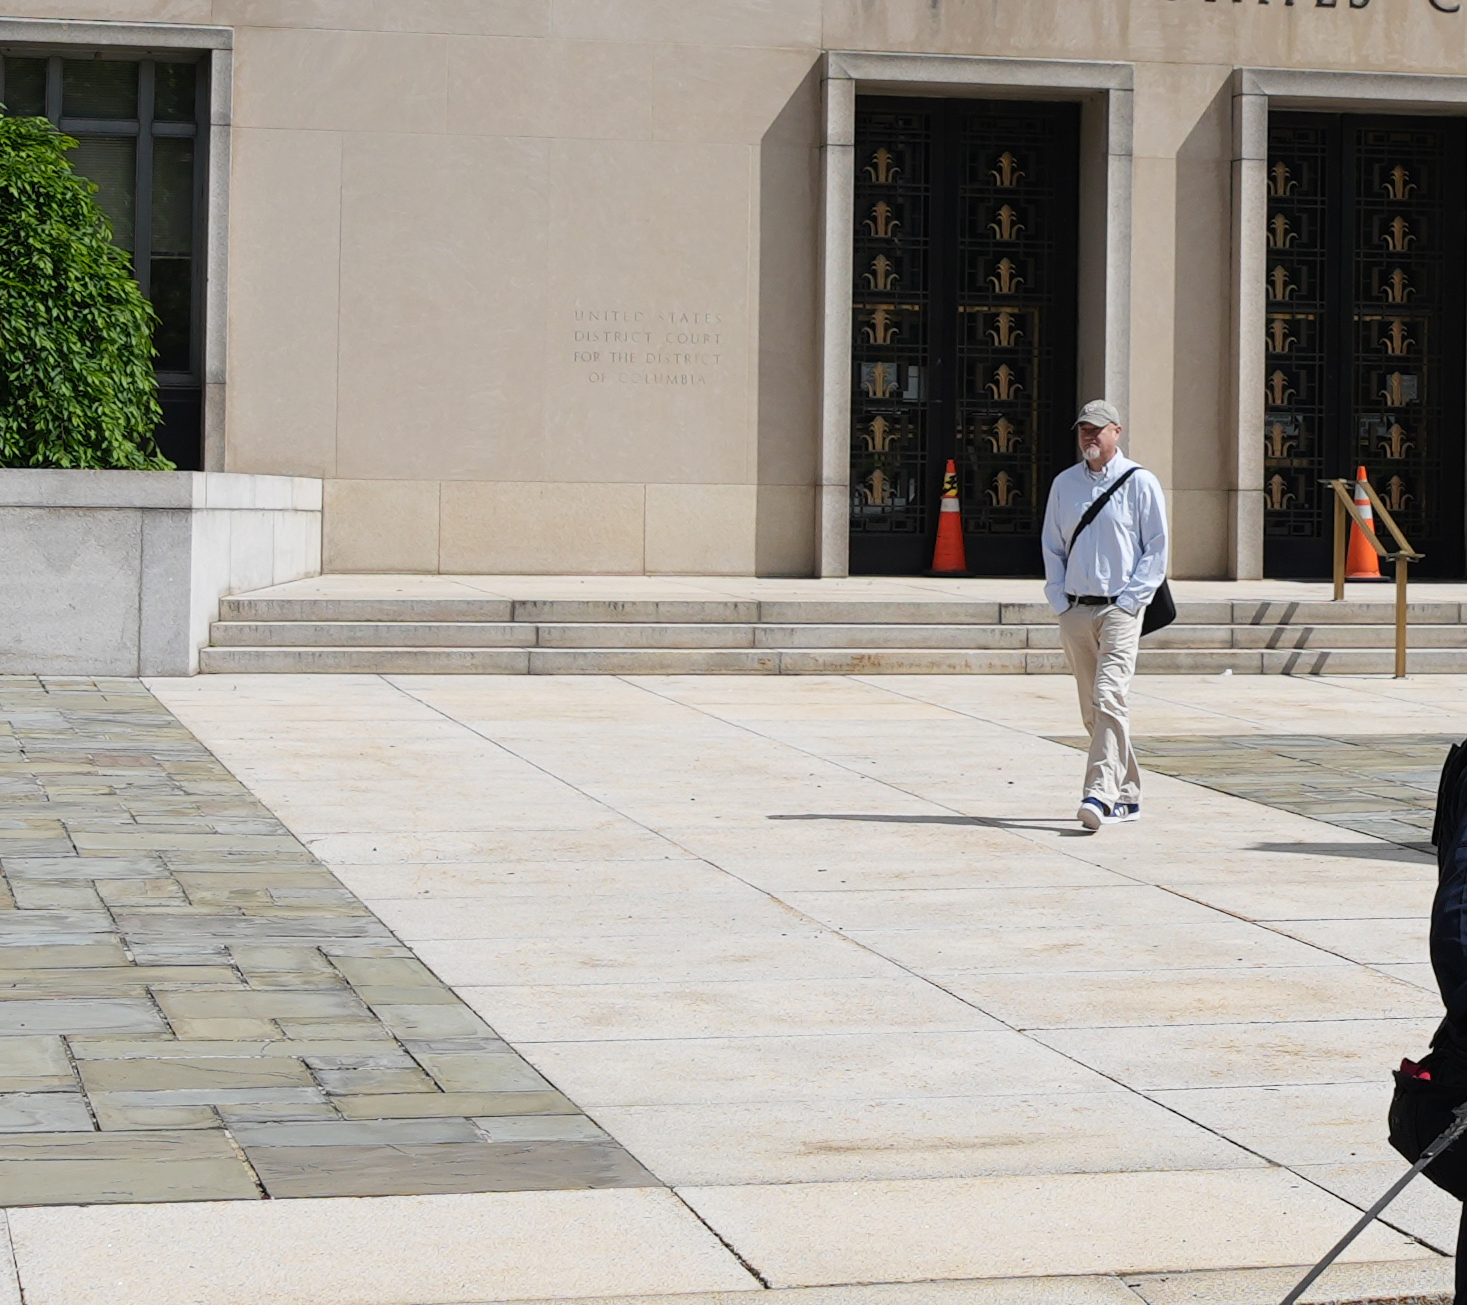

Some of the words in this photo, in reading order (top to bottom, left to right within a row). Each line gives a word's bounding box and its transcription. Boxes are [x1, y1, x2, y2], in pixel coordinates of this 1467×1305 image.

[574, 310, 645, 322] UNITED
[659, 312, 722, 324] STATES
[574, 331, 652, 343] DISTRICT
[665, 333, 722, 344] COURT
[574, 351, 601, 363] FOR
[610, 352, 635, 363] THE
[646, 353, 721, 365] DISTRICT
[588, 371, 608, 383] OF
[618, 372, 706, 385] COLUMBIA
